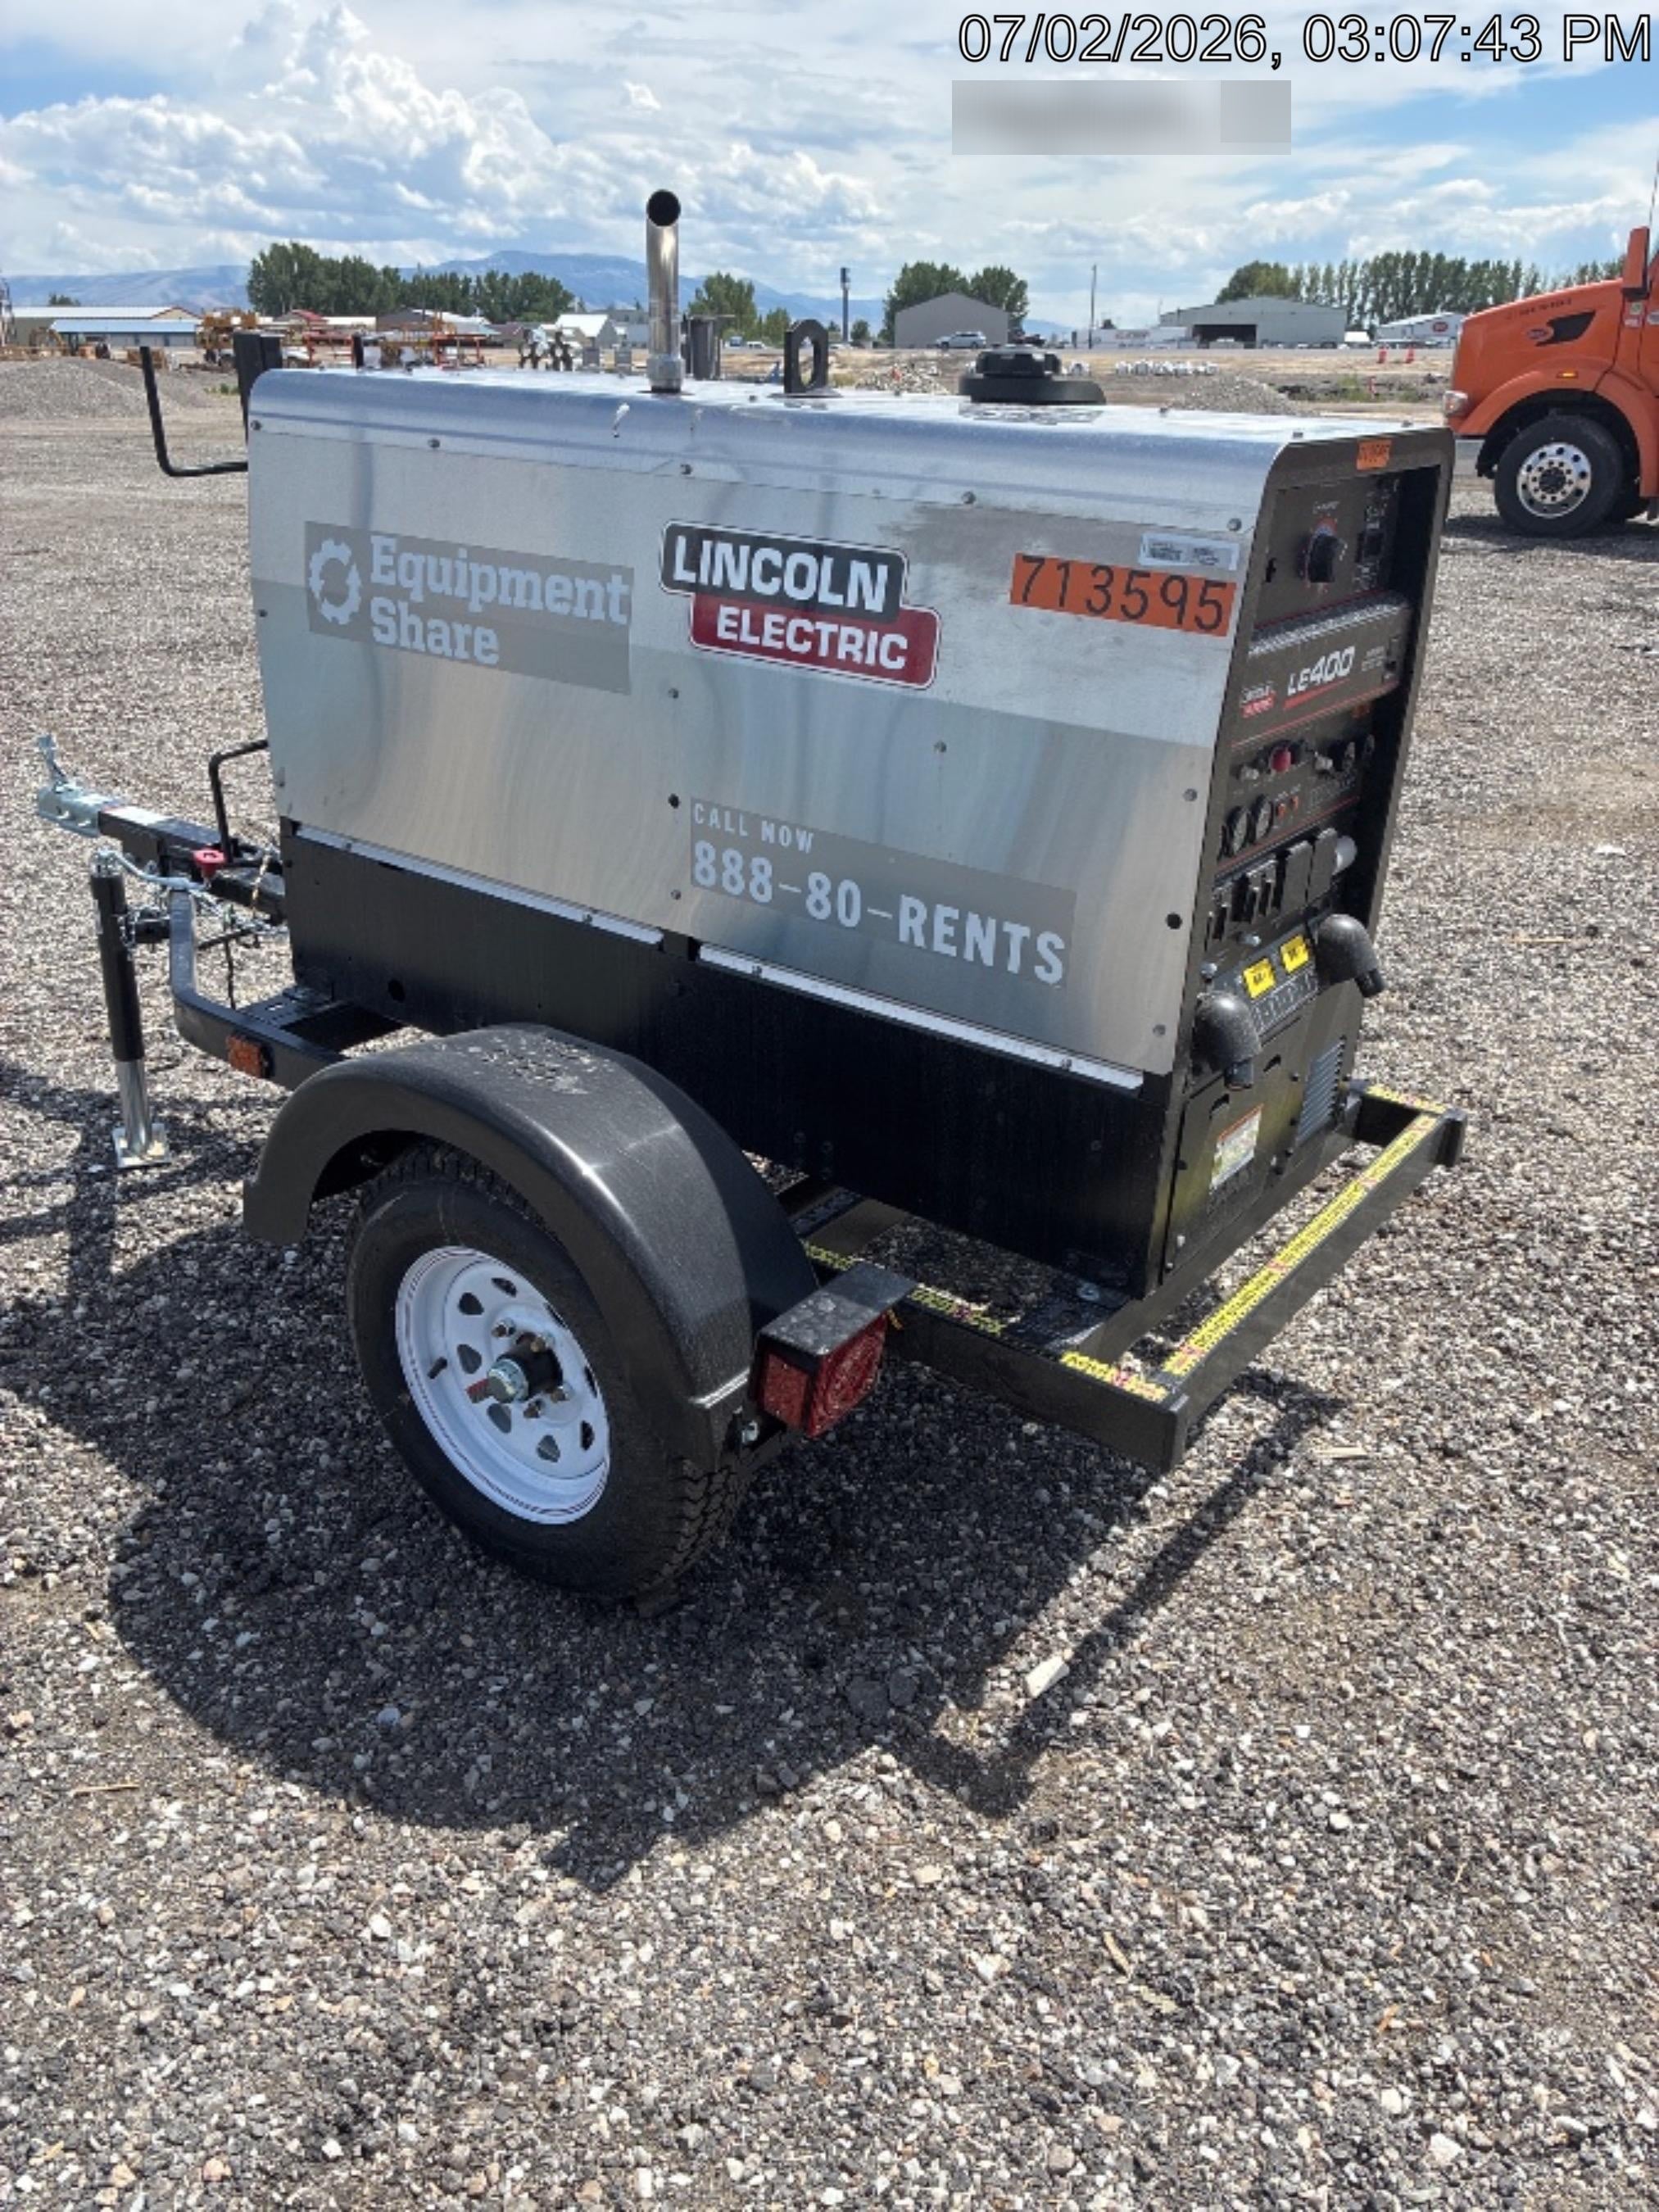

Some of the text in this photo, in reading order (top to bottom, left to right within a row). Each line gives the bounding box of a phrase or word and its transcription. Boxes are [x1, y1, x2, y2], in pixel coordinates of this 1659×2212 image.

[370, 535, 630, 625] Equipment
[673, 535, 888, 613] LINCOLN
[1022, 555, 1227, 631] 713595
[370, 596, 501, 665] Share
[717, 605, 908, 669] ELECTRIC
[1287, 646, 1356, 696] LE400
[694, 803, 815, 854] CALL NOW
[694, 840, 1066, 984] 888-80-RENTS
